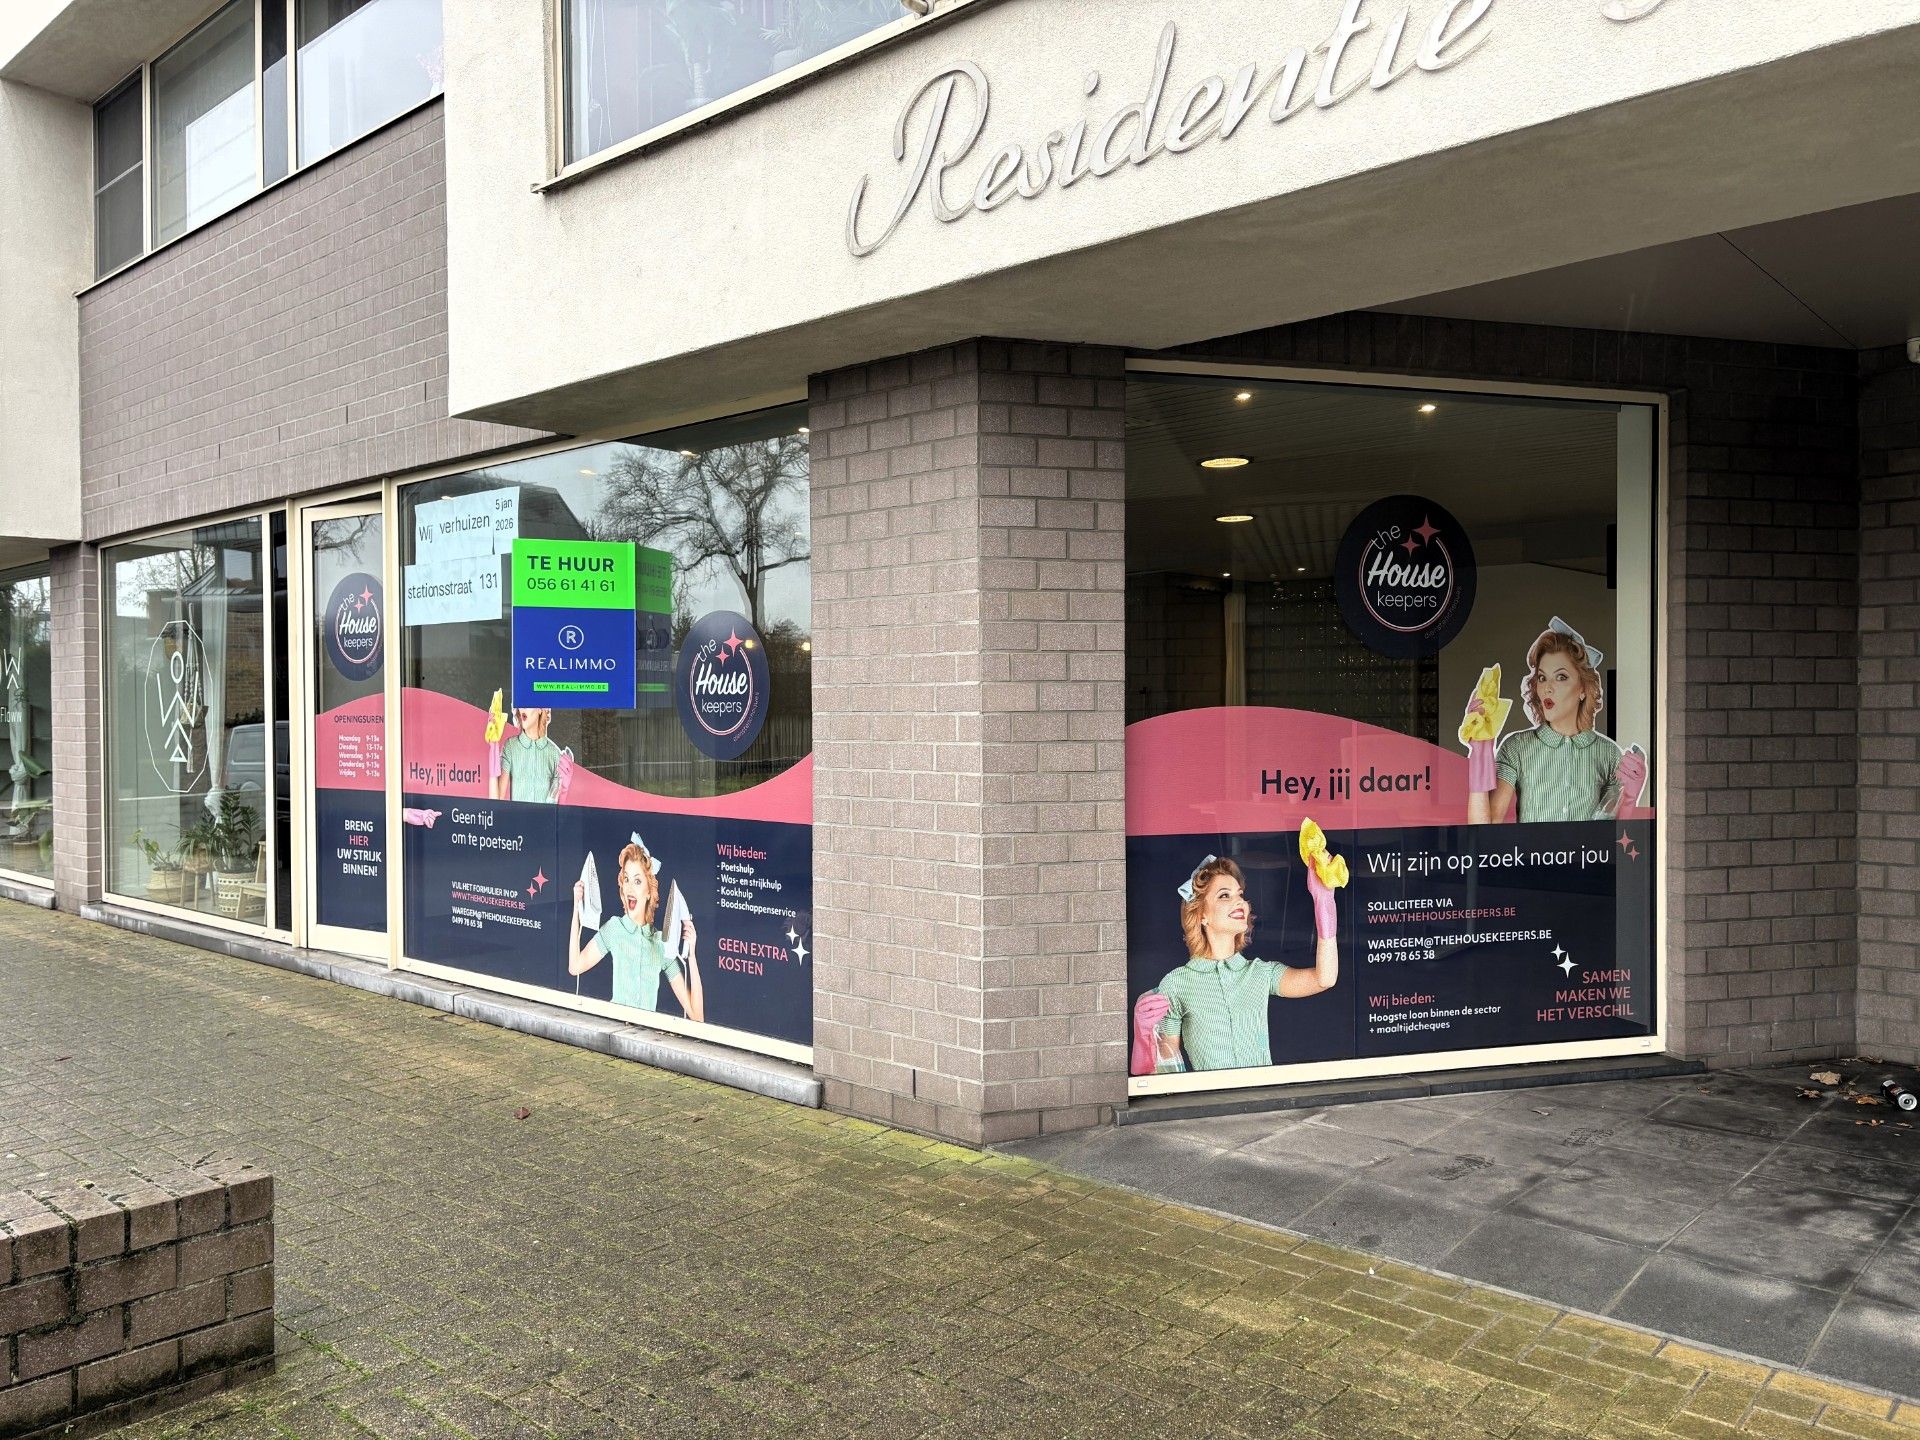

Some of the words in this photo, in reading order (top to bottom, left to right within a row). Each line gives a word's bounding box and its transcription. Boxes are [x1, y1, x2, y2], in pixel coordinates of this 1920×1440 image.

[847, 0, 1493, 257] Residentie
[495, 498, 500, 510] 5
[501, 498, 513, 511] jan
[419, 524, 433, 543] Wij
[440, 514, 490, 534] verhuizen
[495, 518, 514, 531] 2026
[1371, 525, 1401, 550] the
[527, 555, 551, 571] TE
[558, 556, 615, 573] HUUR
[1367, 551, 1446, 588] House
[408, 579, 473, 599] stationsstraat
[480, 572, 498, 590] 131
[527, 577, 557, 591] 056
[560, 578, 576, 591] 61
[581, 579, 595, 592] 41
[600, 579, 615, 592] 61
[340, 592, 355, 610] the
[1377, 590, 1437, 611] keepers
[339, 610, 377, 635] House
[343, 636, 373, 650] keepers
[698, 639, 717, 662] the
[525, 657, 616, 671] REALIMMO
[695, 662, 748, 695] House
[701, 699, 742, 717] keepers
[334, 715, 384, 724] OPENINGSUREN
[409, 762, 434, 783] Hey,
[436, 763, 446, 786] jij
[449, 763, 481, 783] daar!
[1261, 769, 1321, 800] Hey,
[1329, 768, 1350, 800] jij
[1359, 765, 1431, 793] daar!
[344, 820, 374, 832] BRENG
[451, 807, 476, 825] Geen
[477, 811, 493, 831] tijd
[349, 835, 369, 846] HIER
[451, 832, 466, 845] om
[467, 833, 477, 846] te
[479, 835, 523, 851] poetsen?
[336, 848, 353, 859] UW
[353, 850, 382, 862] STRIJK
[716, 843, 732, 859] Wij
[733, 846, 767, 860] bieden:
[342, 863, 378, 877] BINNEN!
[720, 862, 754, 875] Poetshulp
[1367, 852, 1401, 877] Wij
[1407, 851, 1441, 877] zijn
[1447, 854, 1473, 875] op
[1478, 846, 1525, 868] zoek
[1530, 850, 1575, 866] naar
[1581, 845, 1609, 869] jou
[451, 880, 462, 890] VUL
[462, 882, 473, 892] HET
[473, 883, 502, 896] FORMULIER
[502, 888, 510, 897] IN
[510, 889, 518, 899] OP
[720, 874, 739, 884] Was-
[739, 877, 748, 885] en
[749, 877, 782, 891] strijkhulp
[451, 891, 526, 910] WWW.THEHOUSEKEEPERS.BE
[720, 886, 753, 899] Kookhulp
[720, 899, 796, 918] Boodschappenservice
[1367, 899, 1433, 912] SOLLICITEER
[1435, 898, 1453, 909] VIA
[451, 906, 542, 929] WAREGEM@THEHOUSEKEEPERS.BE
[1367, 907, 1516, 924] WWW.THEHOUSEKEEPERS.BE
[1367, 929, 1552, 950] WAREGEM@THEHOUSEKEEPERS.BE
[718, 937, 748, 954] GEEN
[750, 942, 788, 962] EXTRA
[1367, 952, 1393, 963] 0499
[1394, 951, 1407, 962] 78
[1408, 951, 1421, 961] 65
[1422, 950, 1435, 960] 38
[718, 956, 763, 976] KOSTEN
[1582, 969, 1631, 984] SAMEN
[1369, 994, 1389, 1009] Wij
[1391, 993, 1435, 1006] bieden:
[1555, 988, 1606, 1003] MAKEN
[1607, 987, 1631, 999] WE
[1369, 1012, 1407, 1024] Hoogste
[1409, 1009, 1429, 1020] loon
[1430, 1007, 1460, 1018] binnen
[1461, 1005, 1473, 1015] de
[1474, 1005, 1501, 1015] sector
[1537, 1008, 1565, 1022] HET
[1567, 1004, 1634, 1020] VERSCHIL
[1376, 1020, 1450, 1034] maaltijdcheques
